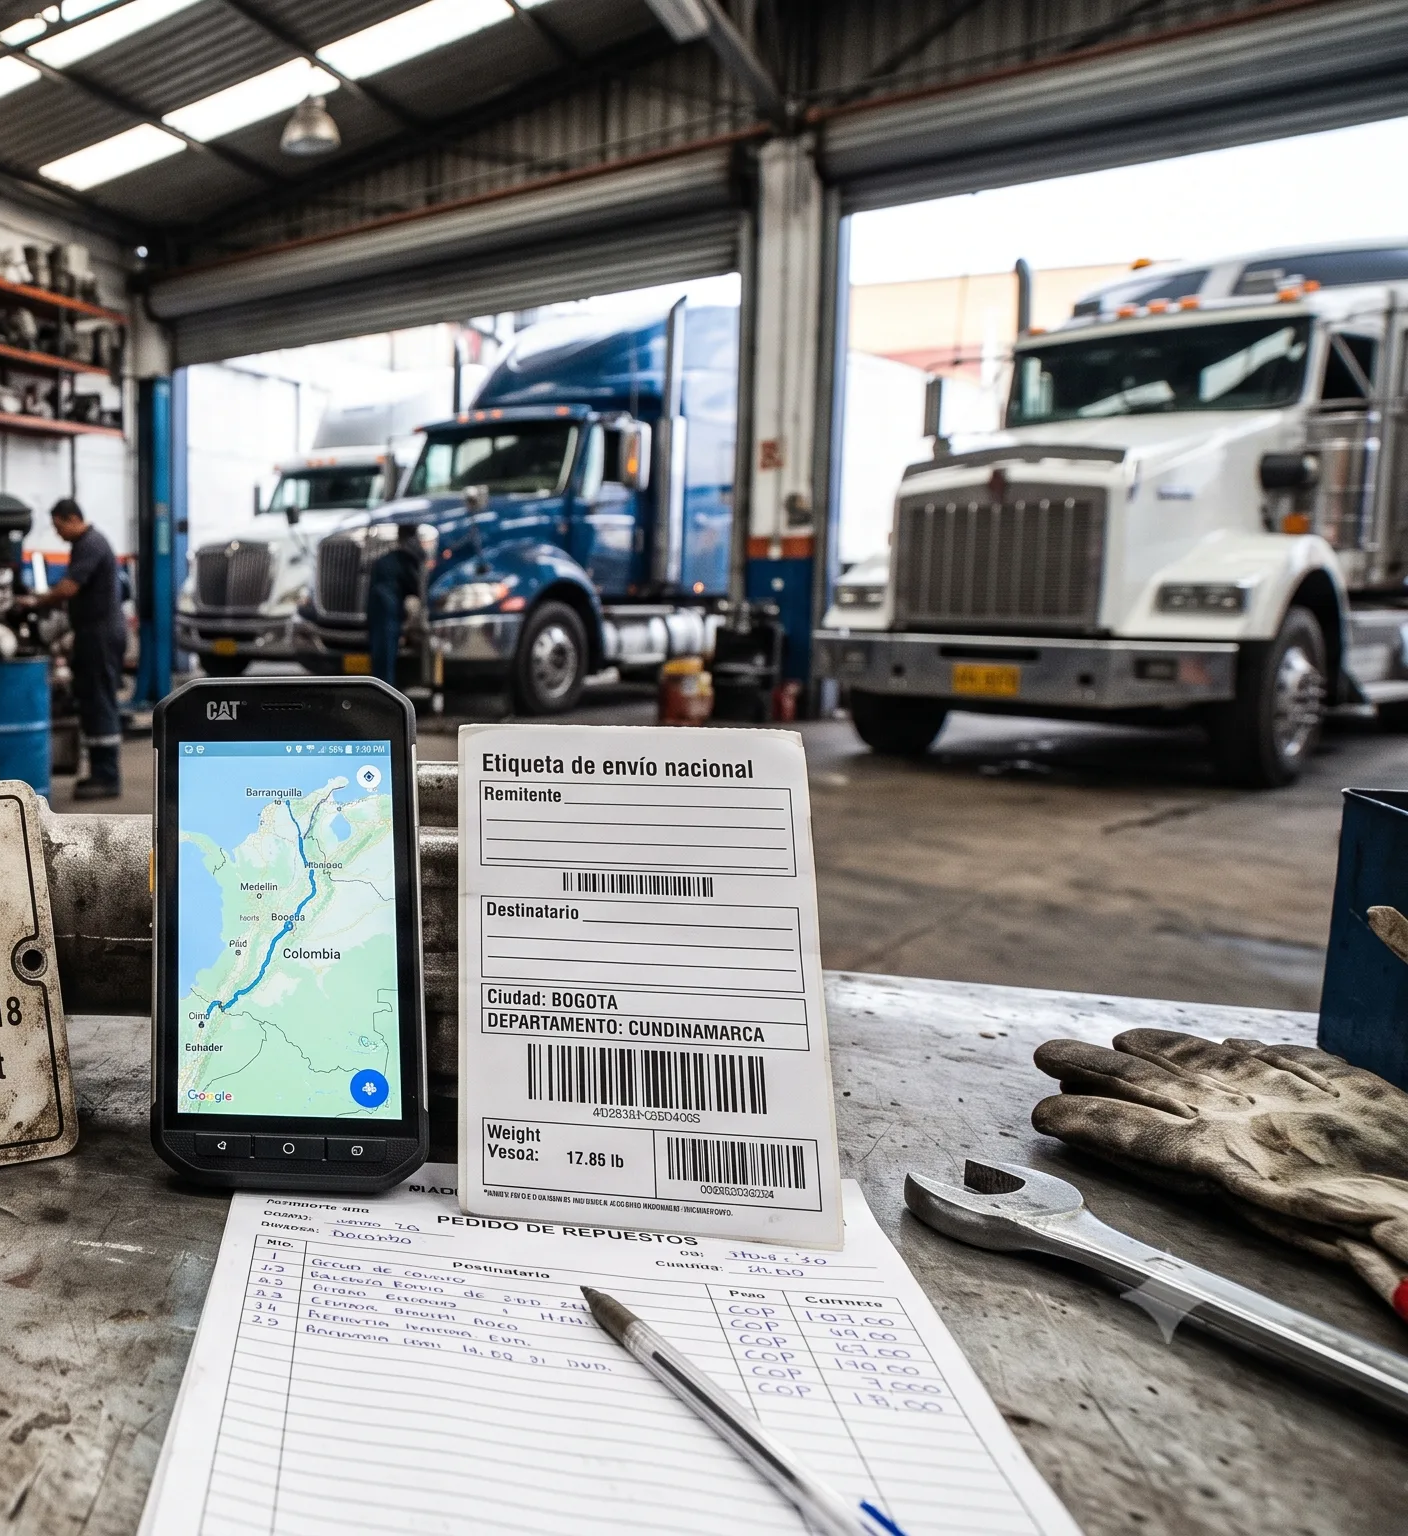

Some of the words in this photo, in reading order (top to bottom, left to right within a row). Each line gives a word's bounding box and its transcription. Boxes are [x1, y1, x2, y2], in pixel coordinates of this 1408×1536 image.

[206, 700, 241, 721] CAT
[483, 754, 564, 777] Etiqueta
[572, 756, 595, 774] de
[603, 757, 657, 776] envío
[665, 759, 753, 778] nacional
[485, 786, 561, 802] Remitente
[240, 882, 278, 892] Medellin
[487, 902, 578, 919] Destinatario
[282, 947, 341, 960] Colombia
[488, 989, 545, 1006] Ciudad:
[552, 992, 618, 1009] BOGOTA
[488, 1013, 622, 1034] DEPARTAMENTO:
[629, 1020, 764, 1042] CUNDINAMARCA
[187, 1088, 233, 1105] Google
[487, 1124, 540, 1144] Weight
[611, 1154, 623, 1168] lb
[438, 1216, 518, 1230] PEDIDO
[527, 1224, 555, 1234] DE
[563, 1227, 698, 1245] REPUESTOS
[728, 1304, 776, 1319] COP
[730, 1319, 780, 1333] COP
[739, 1334, 788, 1349] COP
[744, 1349, 796, 1364] COP
[751, 1365, 803, 1380] COP
[757, 1381, 812, 1399] COP
